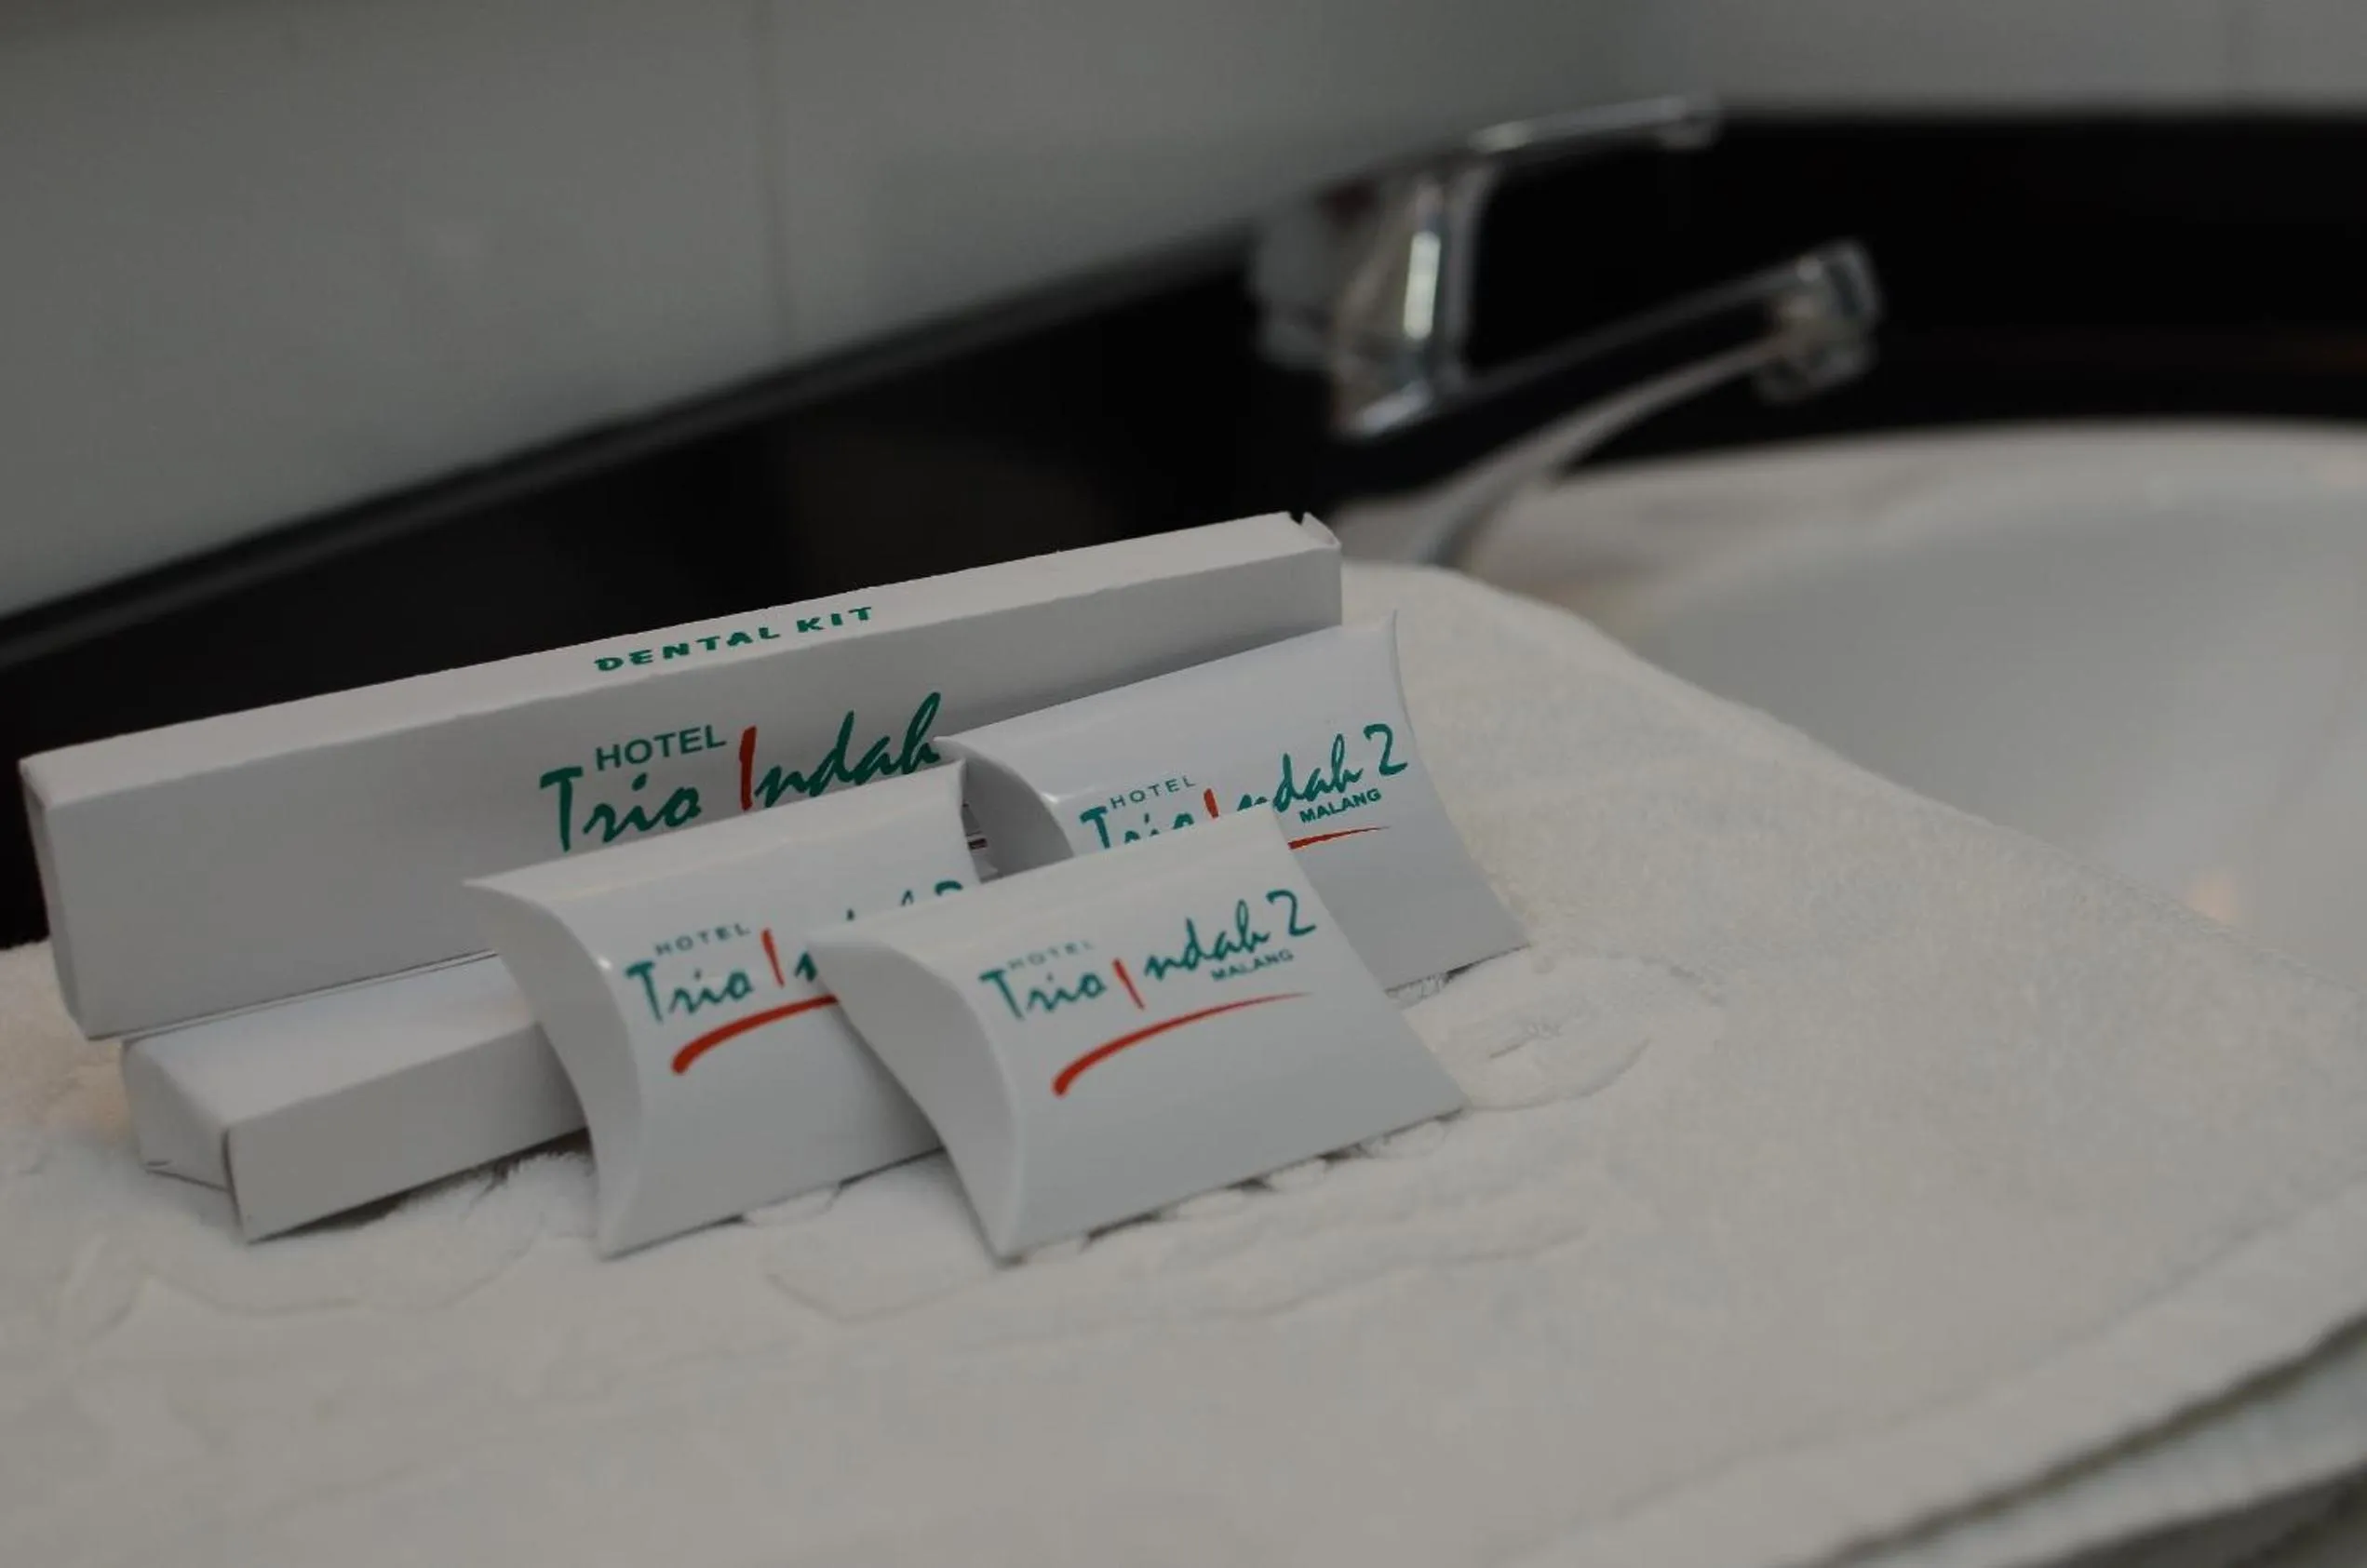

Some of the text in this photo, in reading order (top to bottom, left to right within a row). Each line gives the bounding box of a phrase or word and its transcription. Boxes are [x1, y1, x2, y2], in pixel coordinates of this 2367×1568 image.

[595, 606, 873, 672] DENTAL KIT
[595, 724, 728, 771] HOTEL
[1363, 723, 1408, 776] 2
[539, 691, 942, 852] Trio Indah
[1110, 774, 1197, 811] HOTEL
[1298, 787, 1383, 824] MALANG
[655, 922, 752, 957] HOTEL
[978, 889, 1316, 1021] Trio Indah 2
[1007, 939, 1095, 975] HOTEL
[1211, 949, 1295, 983] MALANG
[624, 959, 755, 1024] Trio
